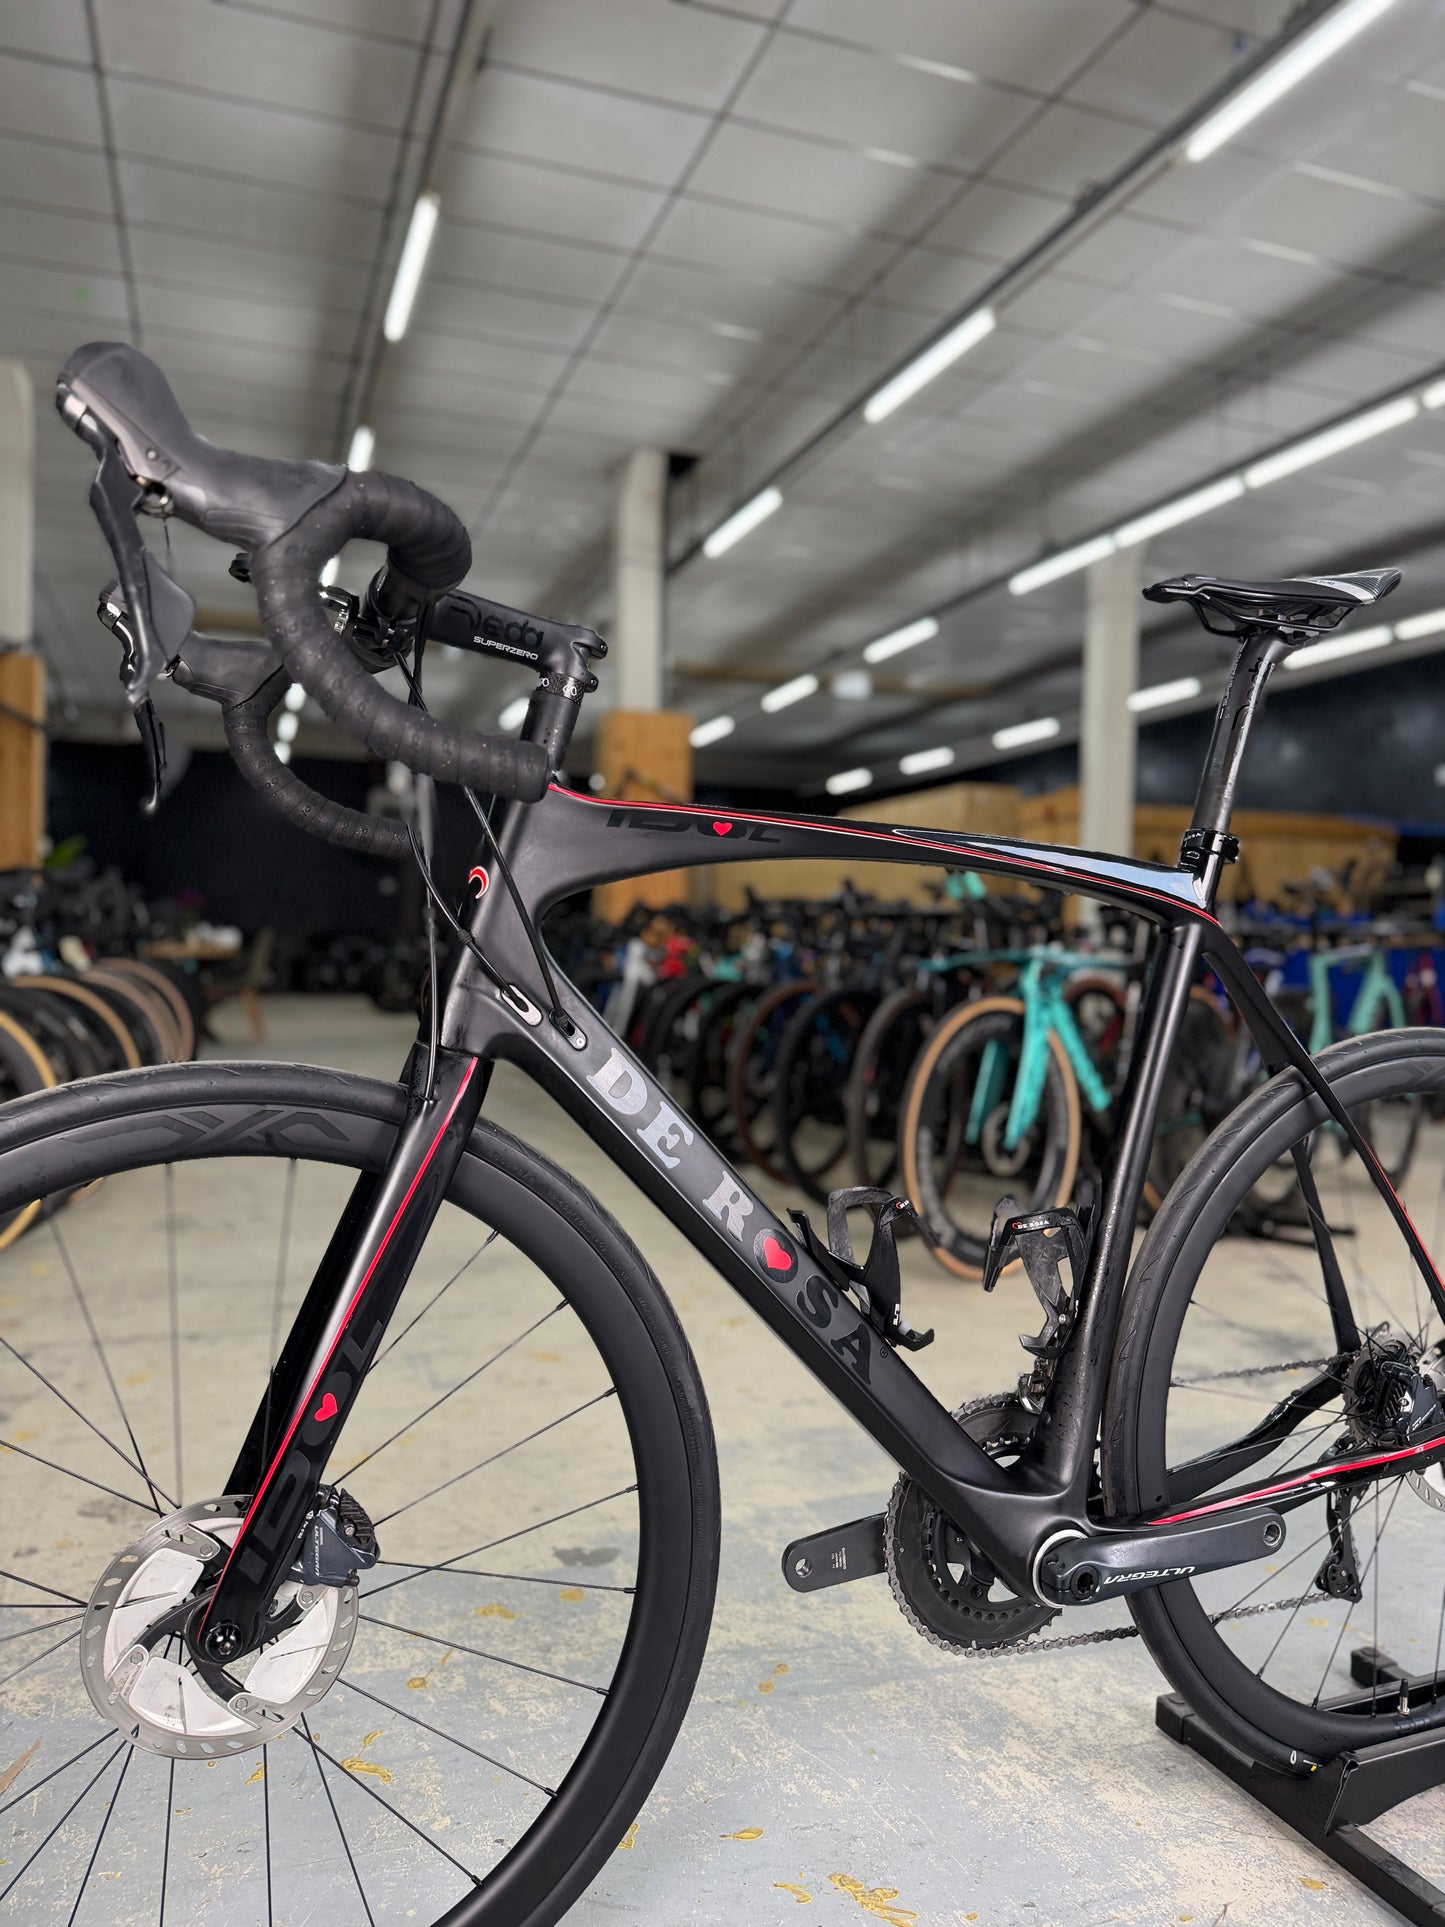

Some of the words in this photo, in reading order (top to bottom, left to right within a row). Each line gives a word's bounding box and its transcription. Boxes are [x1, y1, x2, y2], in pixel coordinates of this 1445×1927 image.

[473, 635, 539, 661] SUPERZERO
[586, 1047, 695, 1169] DE
[702, 1170, 872, 1385] ROSA
[1029, 1220, 1050, 1228] ROSA
[1103, 1565, 1196, 1585] ULTEGRA
